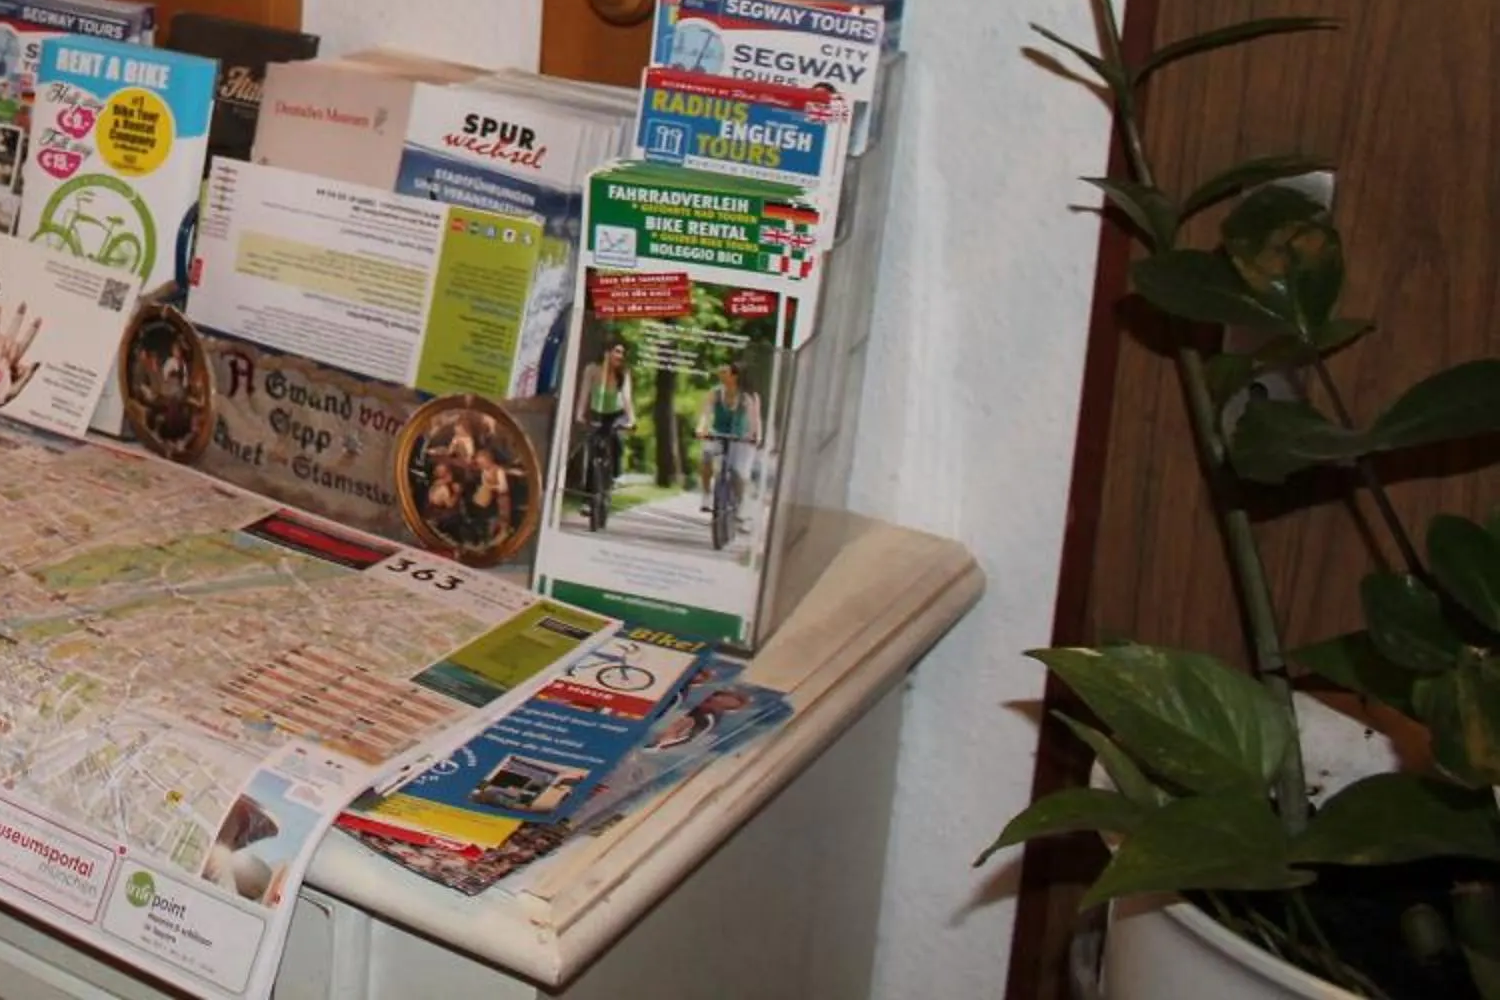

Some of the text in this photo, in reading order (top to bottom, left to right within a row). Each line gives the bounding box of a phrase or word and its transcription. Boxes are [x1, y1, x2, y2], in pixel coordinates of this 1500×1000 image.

[23, 6, 123, 39] SEGWAY TOURS
[810, 12, 877, 40] TOURS
[56, 48, 105, 78] RENT
[106, 55, 121, 81] A
[124, 60, 171, 89] BIKE
[732, 43, 867, 85] SEGWAY
[820, 43, 870, 62] CITY
[652, 88, 749, 123] RADIUS
[463, 113, 536, 150] SPUR
[719, 119, 813, 153] ENGLISH
[442, 132, 548, 169] wechsel
[697, 133, 782, 168] TOURS
[607, 184, 749, 213] FAHRRADVERLEIH
[645, 215, 749, 241] BIKE RENTAL
[649, 243, 743, 265] NOLEGGIO BICI
[220, 349, 255, 398] A
[264, 369, 352, 421] Gwand
[269, 407, 331, 453] Sepp
